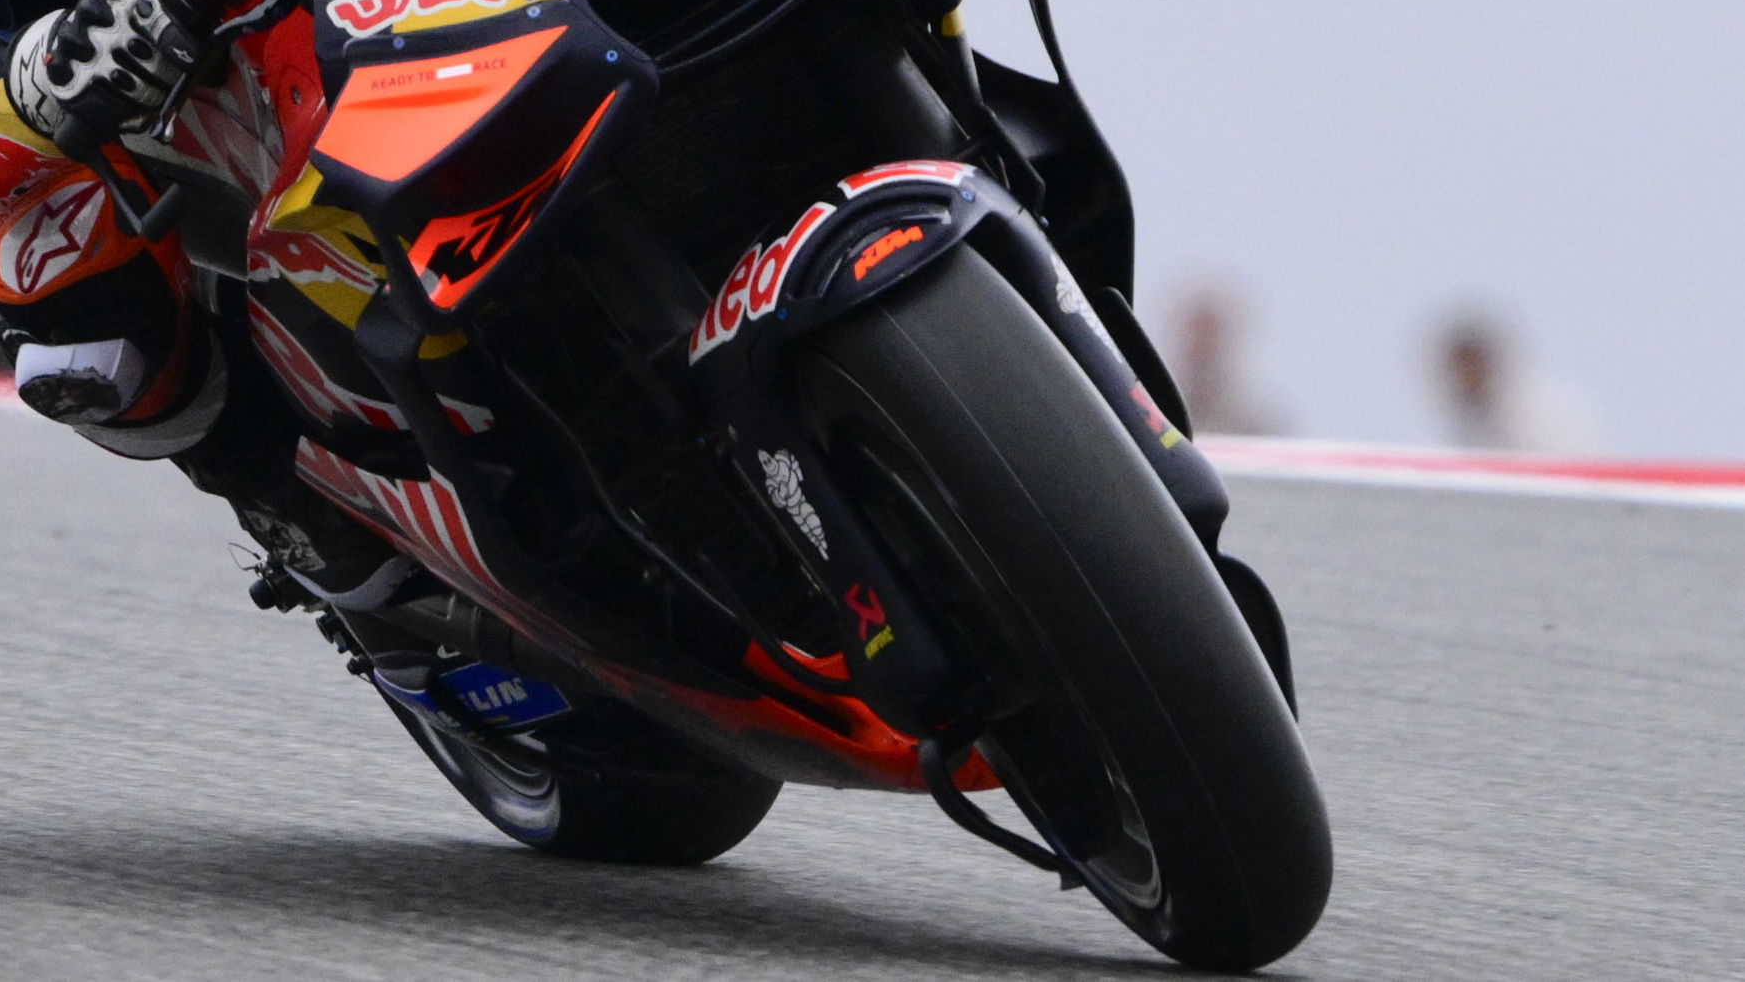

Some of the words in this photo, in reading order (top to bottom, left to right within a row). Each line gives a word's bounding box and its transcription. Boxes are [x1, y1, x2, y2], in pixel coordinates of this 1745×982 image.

[371, 73, 415, 90] READY
[419, 70, 434, 82] TO
[472, 58, 508, 72] RACE
[855, 225, 923, 281] KTM
